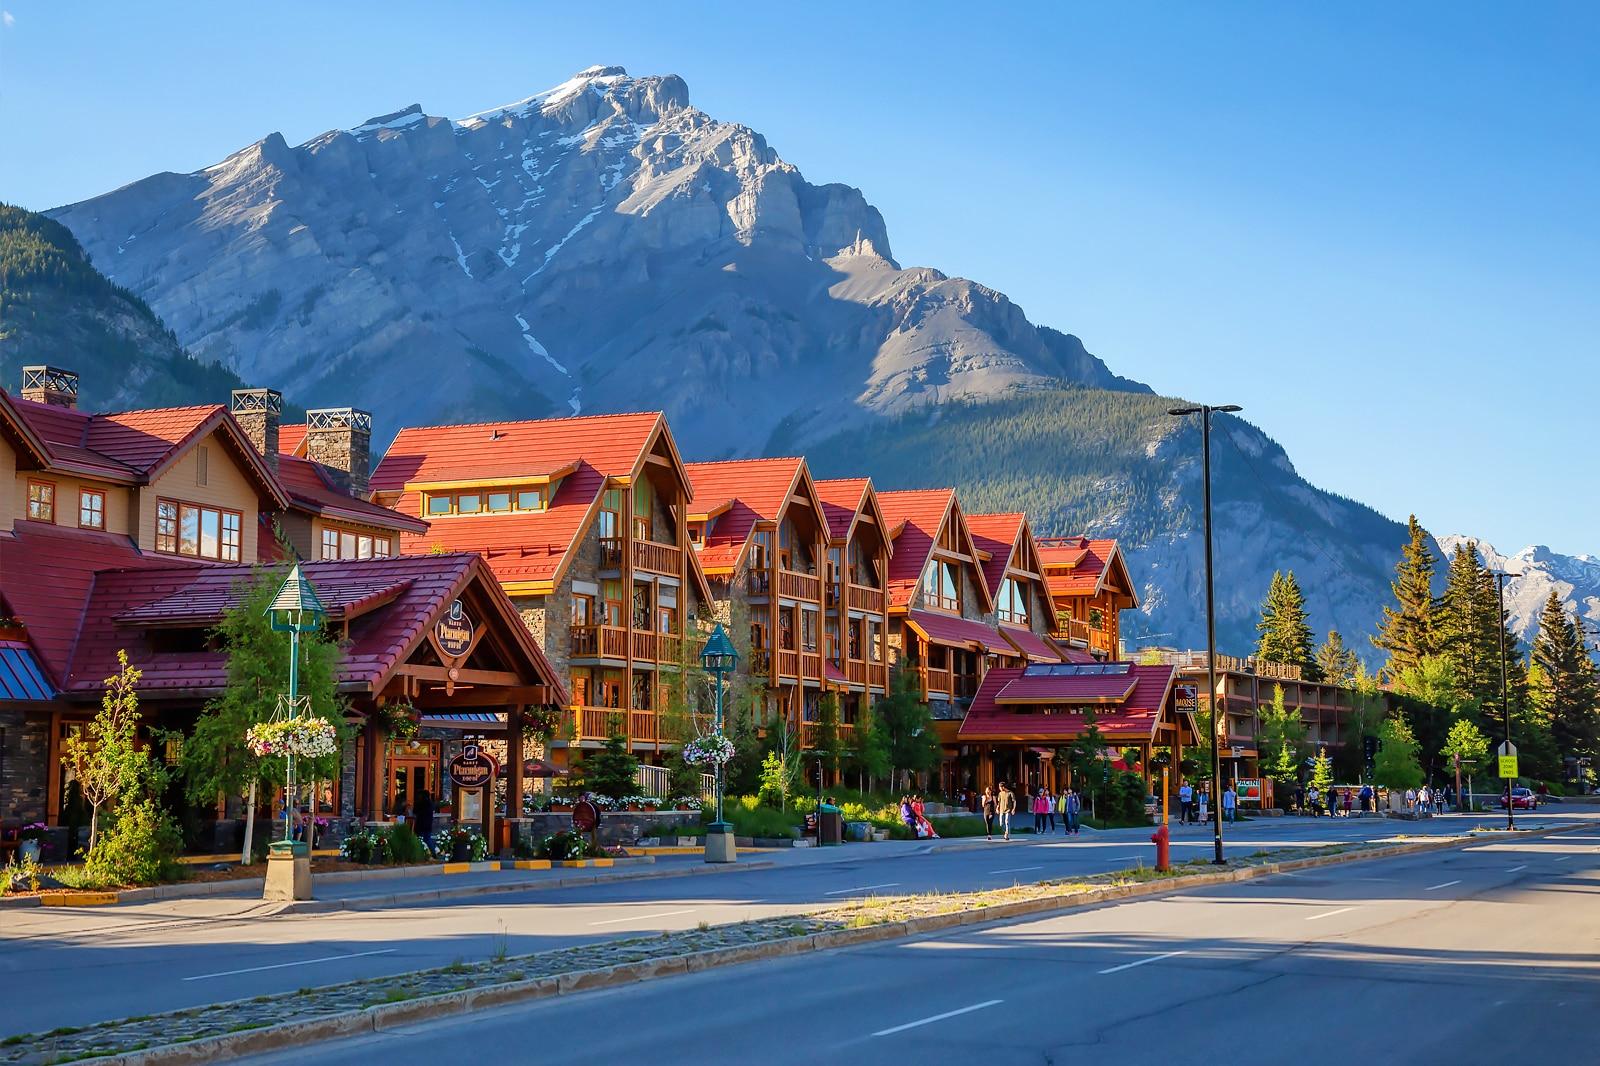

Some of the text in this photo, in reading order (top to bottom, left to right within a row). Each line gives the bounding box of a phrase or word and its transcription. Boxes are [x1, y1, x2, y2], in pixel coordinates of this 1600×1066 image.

[440, 623, 470, 643] Ptarmigan
[1176, 699, 1196, 707] MOOSE
[453, 764, 488, 778] Ptarmigan
